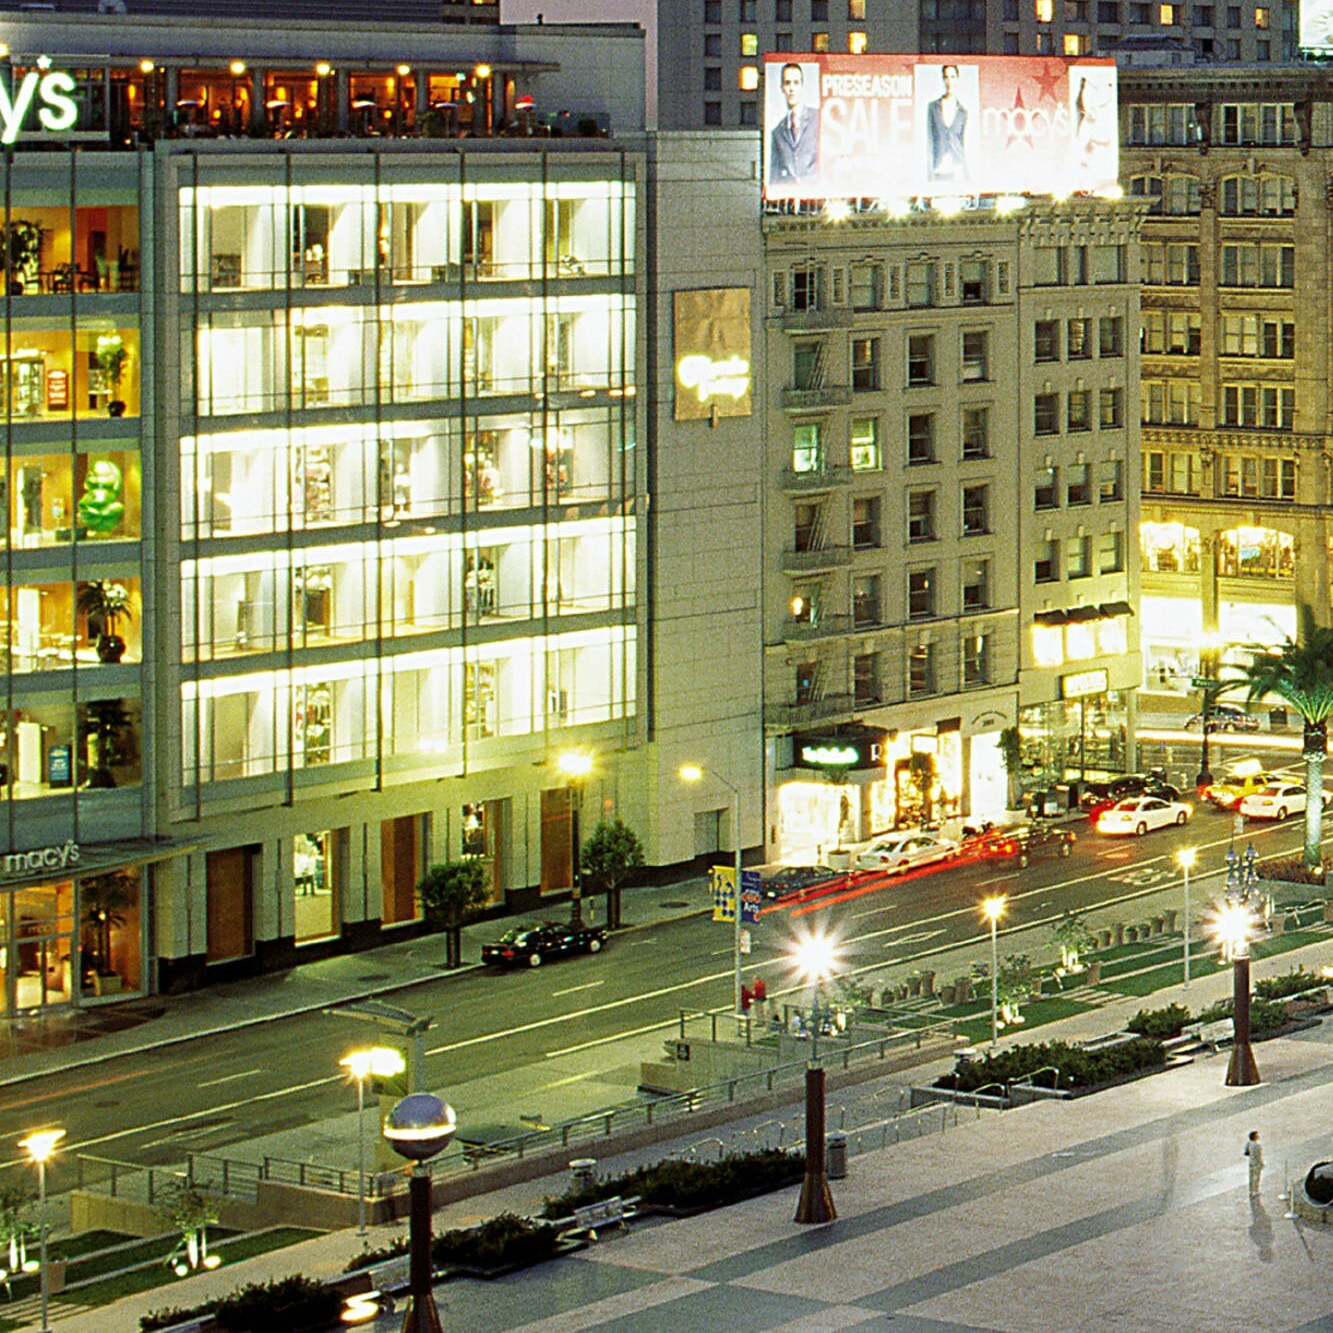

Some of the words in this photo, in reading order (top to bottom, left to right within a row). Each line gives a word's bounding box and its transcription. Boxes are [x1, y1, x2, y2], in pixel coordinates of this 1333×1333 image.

[822, 74, 913, 98] PRESEASON
[822, 98, 913, 155] SALE
[982, 102, 1069, 138] macy's
[4, 839, 80, 873] macy's
